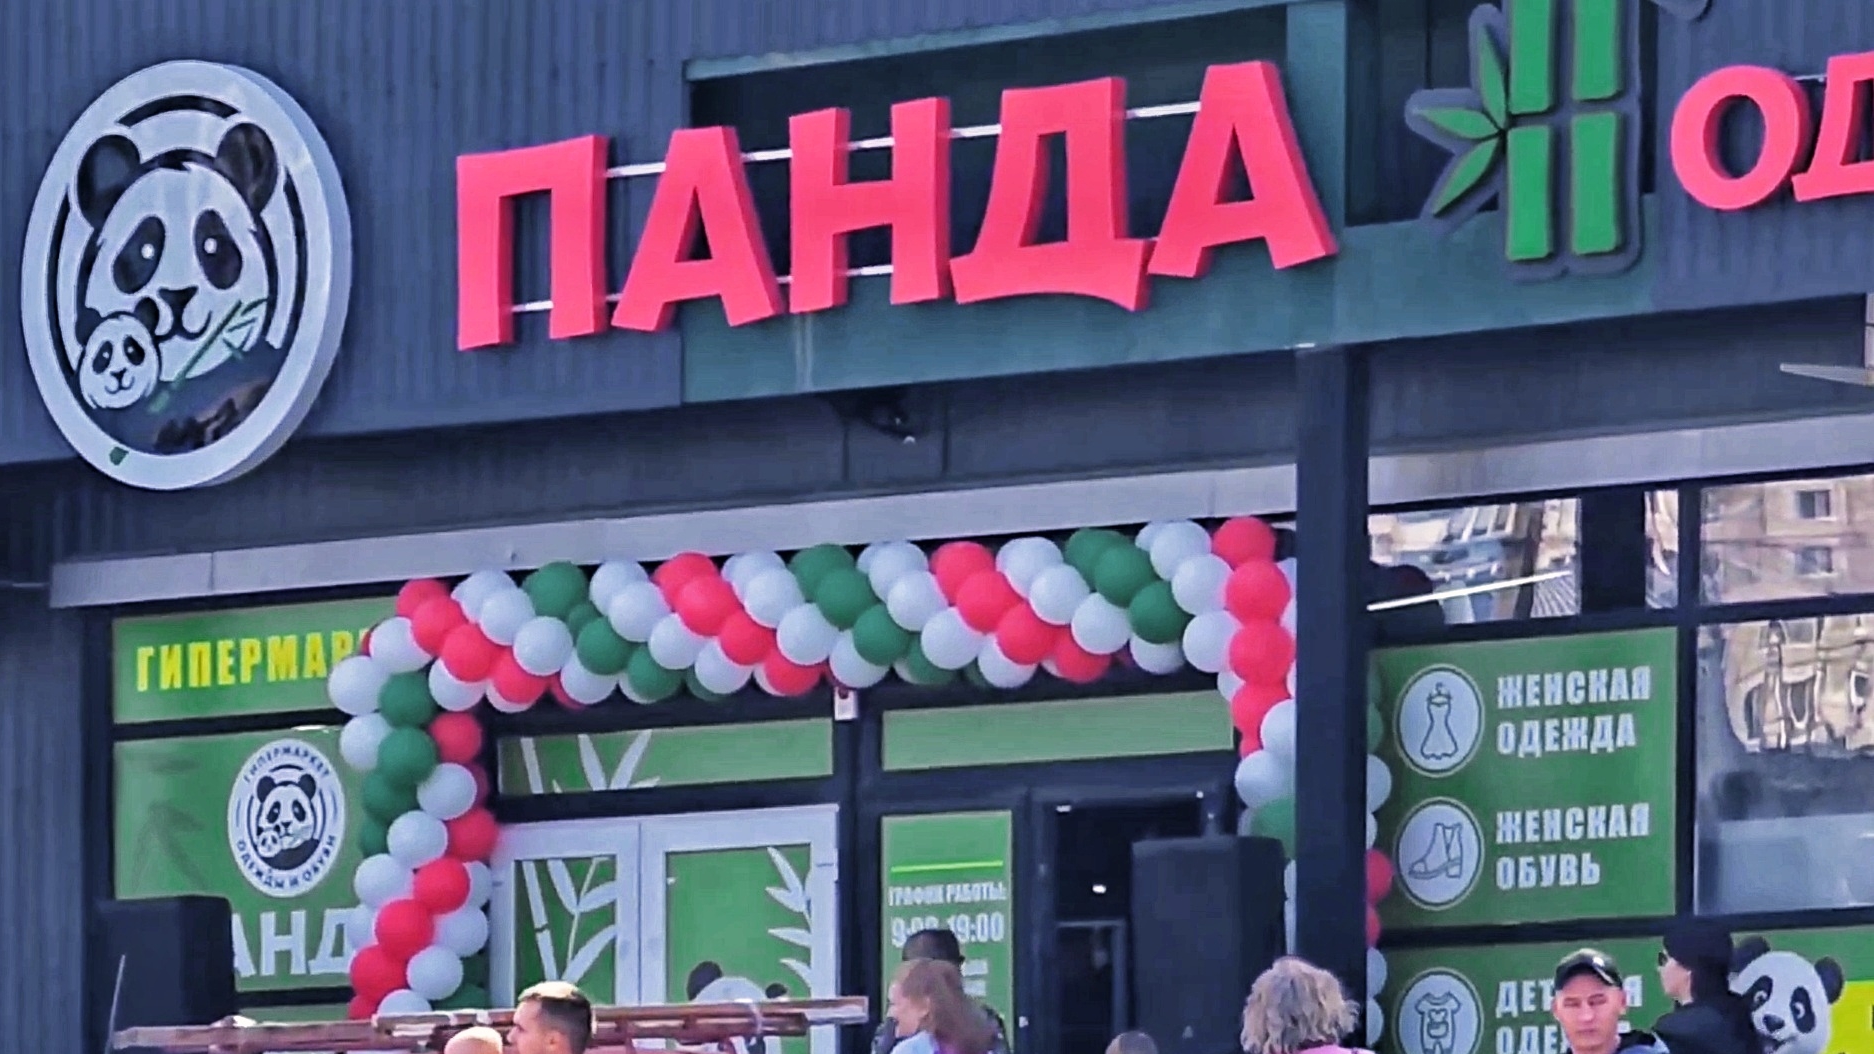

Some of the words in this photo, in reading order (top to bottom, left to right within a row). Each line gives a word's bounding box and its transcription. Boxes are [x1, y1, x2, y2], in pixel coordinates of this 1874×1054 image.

[456, 60, 1339, 351] ПАНДА
[136, 628, 368, 693] ГИПЕРМАР
[1497, 665, 1653, 709] ЖЕНСКАЯ
[1497, 712, 1638, 758] ОДЕЖДА
[1496, 802, 1652, 844] ЖЕНСКАЯ
[1496, 849, 1602, 890] ОБУВЬ
[1495, 973, 1643, 1018] ДЕТЯ
